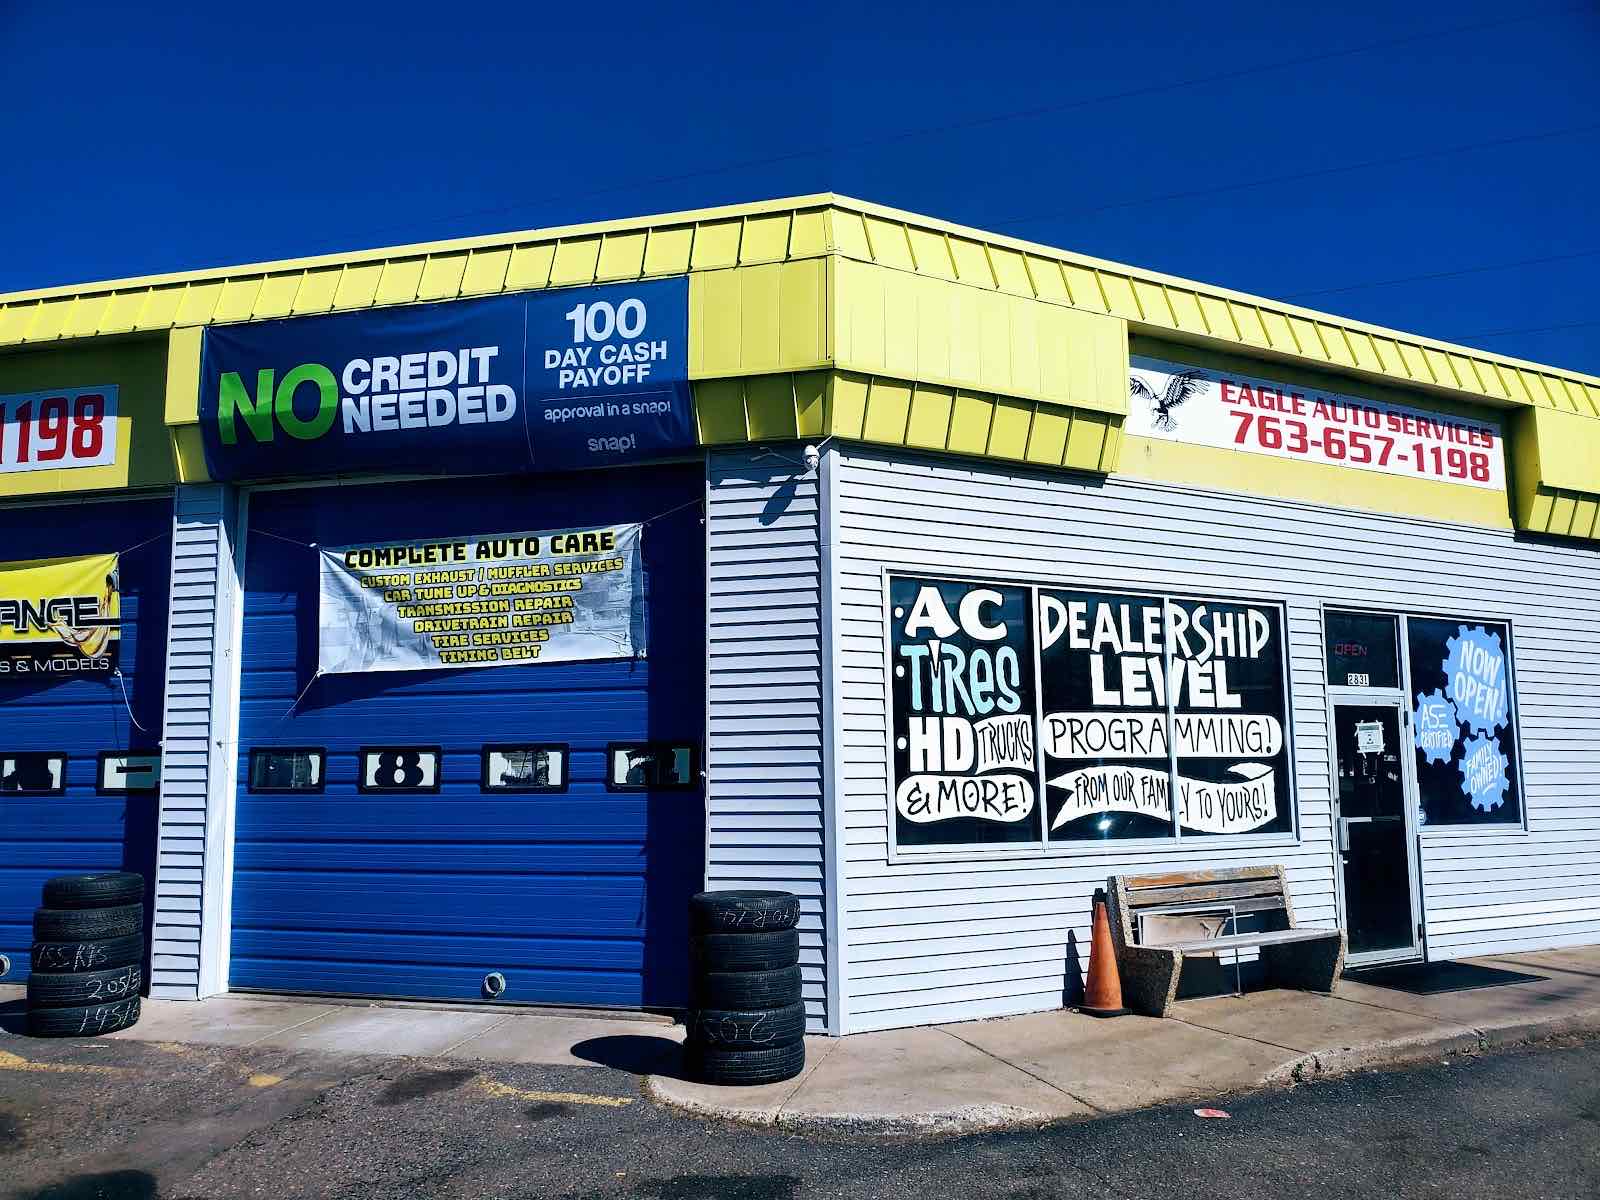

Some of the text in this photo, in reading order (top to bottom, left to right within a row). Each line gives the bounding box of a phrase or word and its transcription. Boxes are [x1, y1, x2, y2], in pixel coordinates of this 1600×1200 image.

[565, 298, 647, 343] 100
[342, 346, 499, 395] CREDIT
[544, 340, 667, 369] DAY CASH
[559, 363, 651, 389] PAYOFF
[218, 363, 339, 444] NO
[342, 384, 517, 434] NEEDED
[544, 401, 671, 423] approval in a snap!
[1220, 379, 1494, 449] EAGLE AUTO SERVICES
[587, 433, 636, 453] snap!
[1229, 410, 1490, 482] 763-657-1198
[344, 532, 615, 569] COMPLETE AUTO CARE
[360, 573, 411, 588] CUSTOM
[414, 569, 476, 585] EXHAUST
[487, 564, 550, 580] MUFFLER
[553, 557, 624, 576] SERVICES
[384, 589, 411, 602] CAR
[415, 585, 453, 601] TUNE
[491, 576, 583, 597] DIAGNOSTICS
[397, 594, 574, 618] TRANSMISSION REPAIR
[414, 610, 574, 633] DRIVETRAIN REPAIR
[904, 585, 1008, 641] AC
[432, 629, 549, 648] TIRE SERVICES
[1040, 595, 1270, 665] DEALERSHIP
[16, 660, 30, 672] &
[34, 658, 110, 672] MODELS
[439, 644, 541, 663] TIMING BELT
[1335, 643, 1368, 656] OPEN
[1460, 640, 1502, 687] NOW
[1090, 653, 1241, 708] LEVEL
[1348, 673, 1368, 685] 2831
[1454, 672, 1505, 722] OPEN!
[1421, 703, 1449, 729] ASE
[908, 716, 1033, 772] HD TRUCKS
[1049, 717, 1272, 755] PROGRAMMING!
[907, 779, 1026, 817] & MORE!
[1074, 771, 1268, 827] FROM OUR FAMY TO YOURS!
